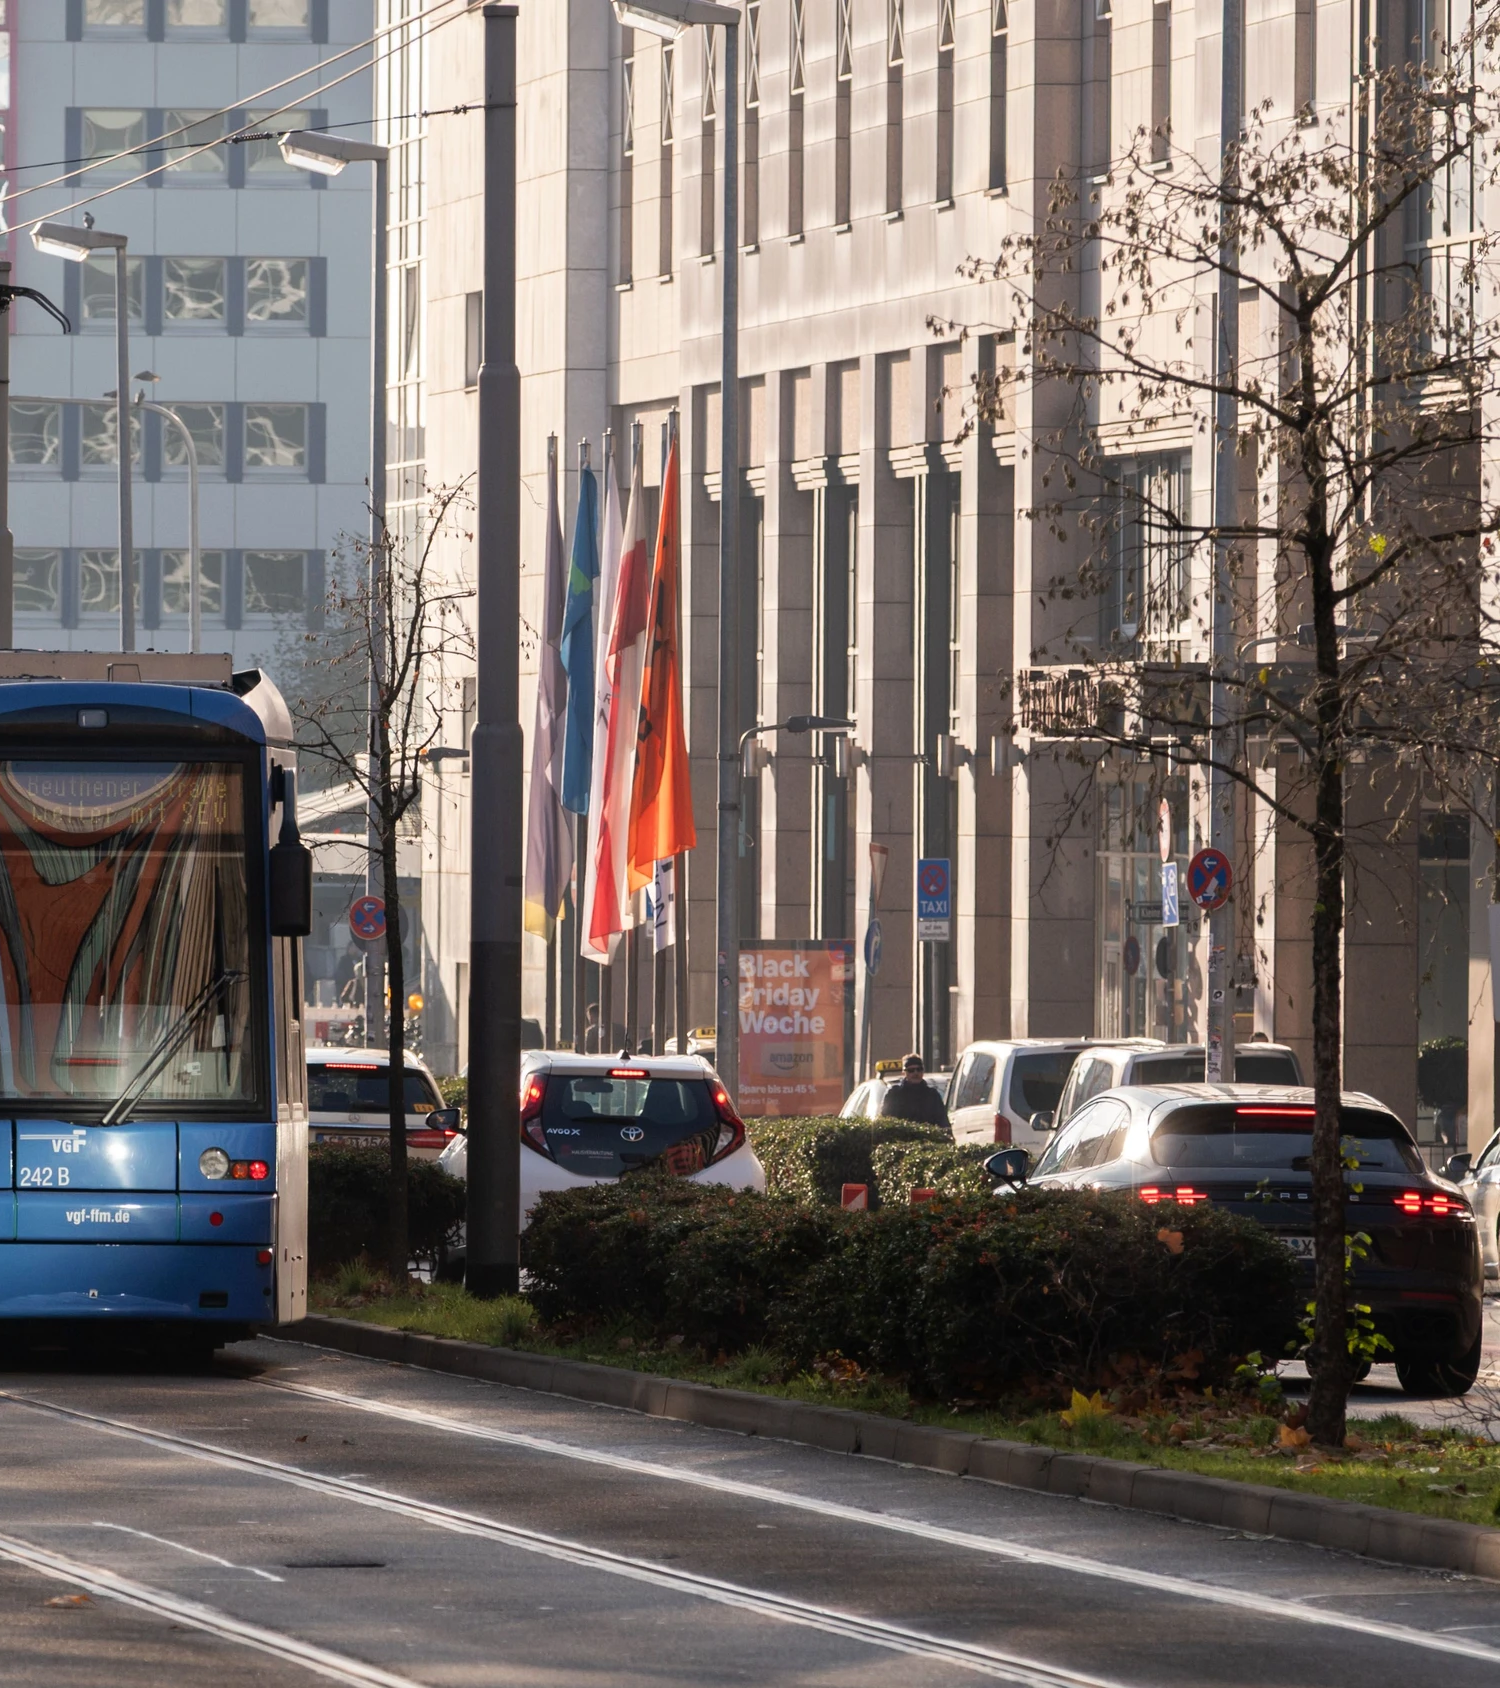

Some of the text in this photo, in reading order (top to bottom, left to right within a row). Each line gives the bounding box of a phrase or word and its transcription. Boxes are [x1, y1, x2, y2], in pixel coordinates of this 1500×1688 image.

[27, 775, 228, 800] Beuthener Straße
[32, 799, 228, 826] weiter mit SEV
[919, 900, 947, 914] TAXI
[739, 953, 810, 978] Black
[739, 982, 820, 1011] Friday
[739, 1010, 825, 1034] Woche
[769, 1052, 814, 1063] amazon
[739, 1084, 817, 1095] Spare bis zu 45 %
[51, 1129, 86, 1153] VGF
[546, 1127, 580, 1136] AYGO X
[20, 1167, 70, 1187] 242 B
[1244, 1192, 1360, 1202] PORSE
[65, 1208, 130, 1225] vgf-ffm.de
